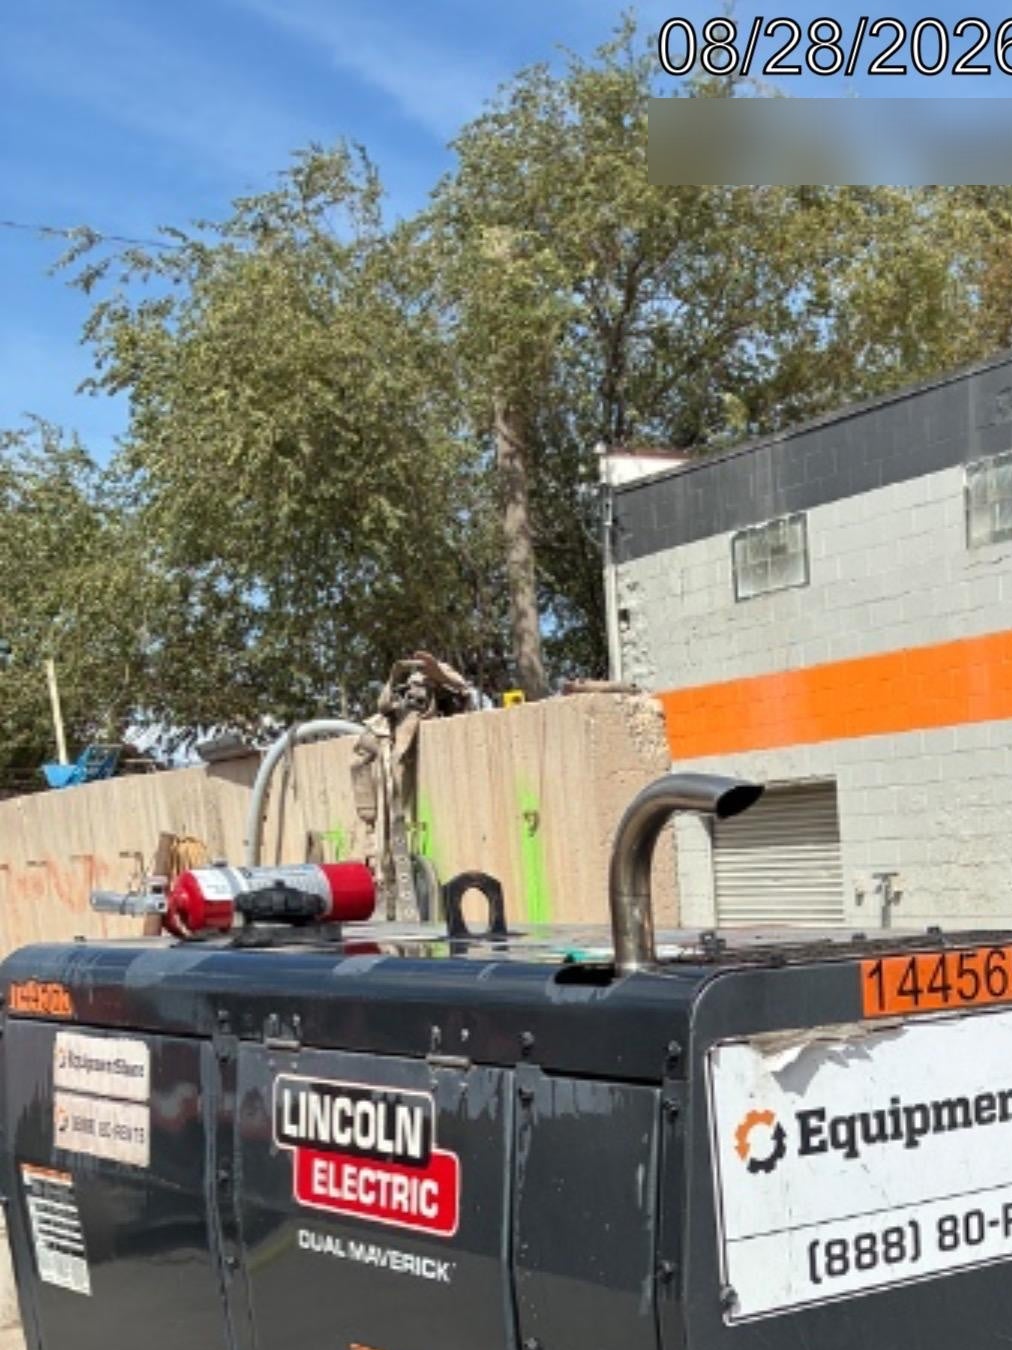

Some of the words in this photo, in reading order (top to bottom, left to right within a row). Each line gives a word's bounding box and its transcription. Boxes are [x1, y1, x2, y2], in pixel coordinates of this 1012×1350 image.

[282, 1088, 423, 1158] LINCOLN
[312, 1157, 439, 1219] ELECTRIC
[298, 1229, 346, 1258] DUAL
[349, 1241, 450, 1282] MAVERICK
[808, 1219, 921, 1285] (888)
